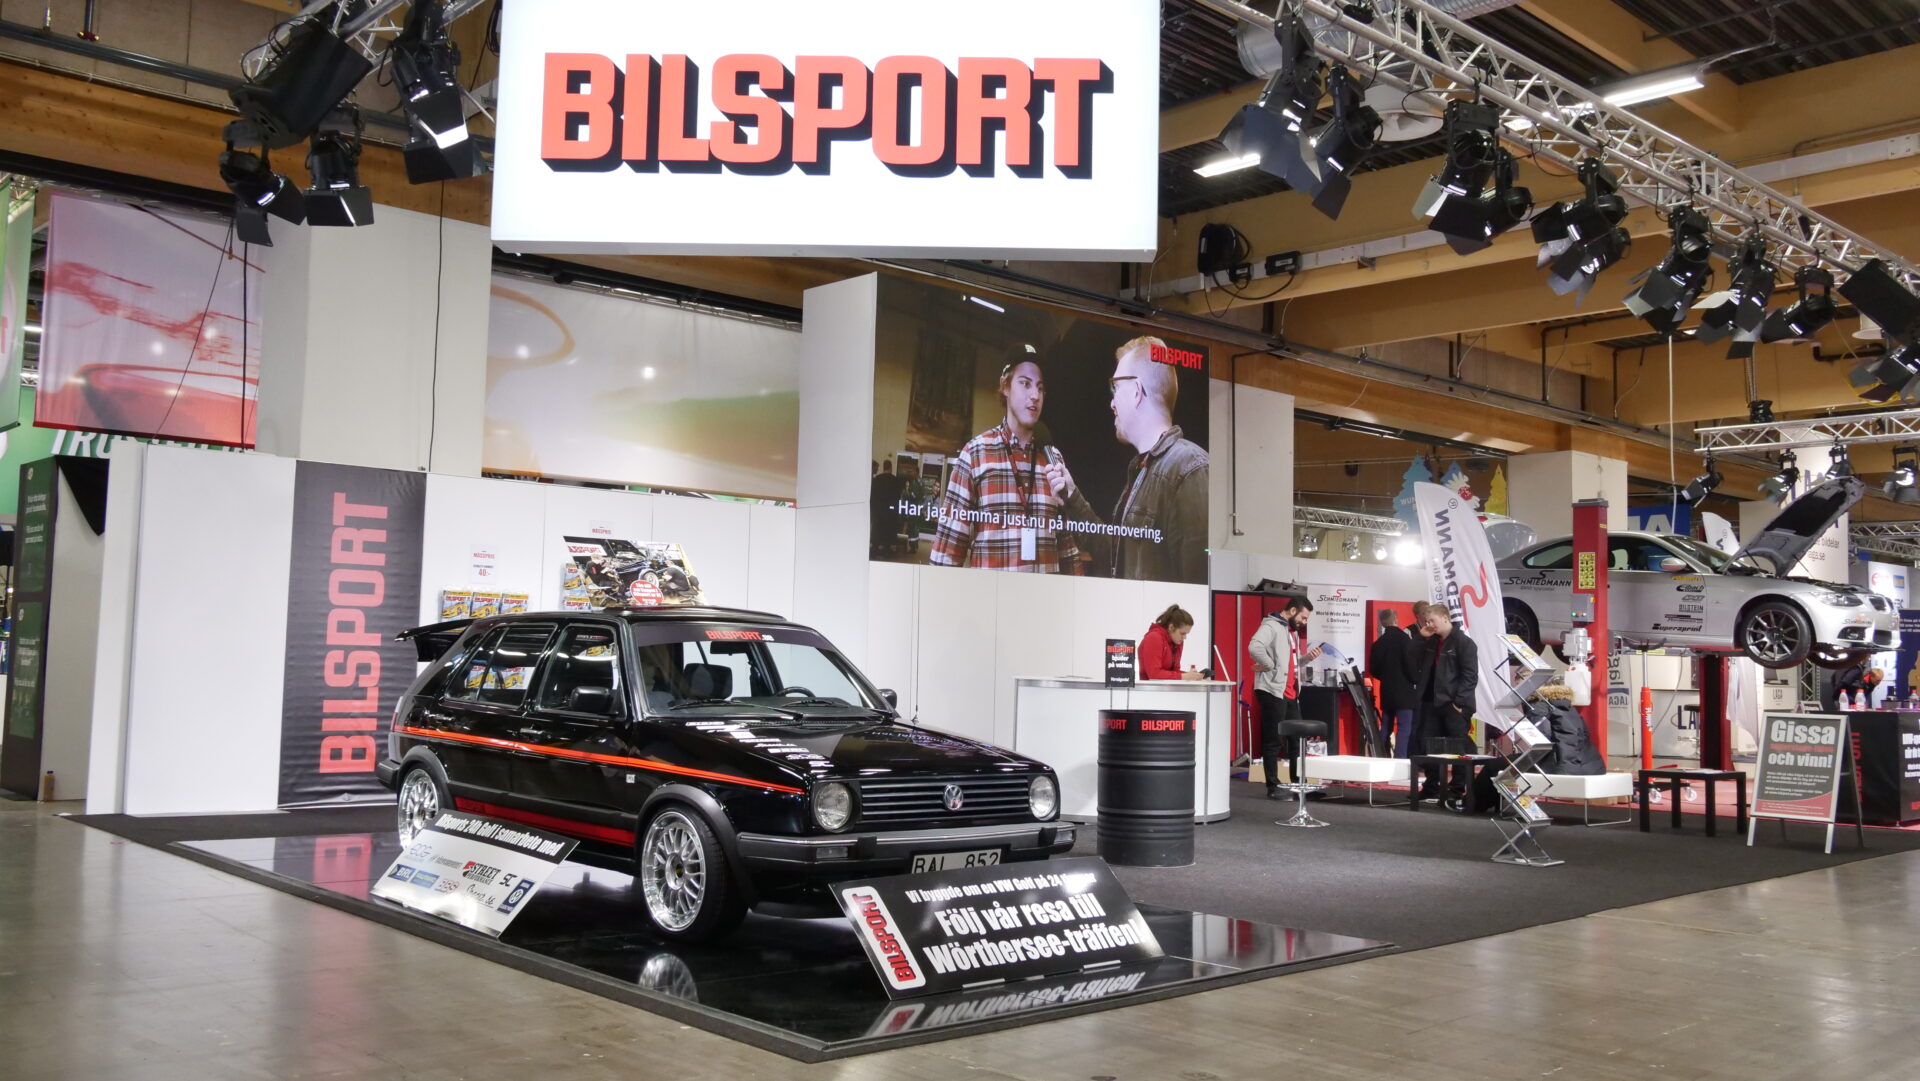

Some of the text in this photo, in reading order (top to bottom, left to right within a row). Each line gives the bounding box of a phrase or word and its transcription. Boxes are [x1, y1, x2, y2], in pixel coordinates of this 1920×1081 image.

[541, 52, 1114, 179] BILSPORT
[1150, 344, 1203, 370] BILSPORT
[898, 499, 923, 516] Har
[925, 502, 947, 523] jag
[951, 507, 1000, 524] hemma
[1002, 511, 1026, 529] just
[1029, 516, 1045, 528] nu
[1049, 514, 1063, 533] på
[1066, 519, 1164, 544] motorrenovering.
[1503, 576, 1572, 587] SCHMIEDMANN
[319, 492, 389, 774] BILSPORT
[1141, 720, 1185, 731] BILSPORT
[1770, 719, 1836, 745] Gissa
[1768, 752, 1833, 768] och vinn!
[495, 828, 543, 850] samarbete
[535, 839, 566, 857] med
[469, 863, 502, 880] STREET
[965, 852, 999, 868] 852
[905, 890, 922, 903] Vi
[919, 885, 963, 903] byggde
[965, 886, 982, 897] om
[983, 883, 997, 895] en
[993, 879, 1015, 893] VW
[1012, 877, 1034, 891] Golf
[1033, 875, 1050, 889] på
[1048, 875, 1063, 888] 24
[934, 893, 1106, 937] Följ vår resa till
[852, 893, 916, 982] BILSPORT
[922, 918, 1147, 974] Wörthersee-träffen!
